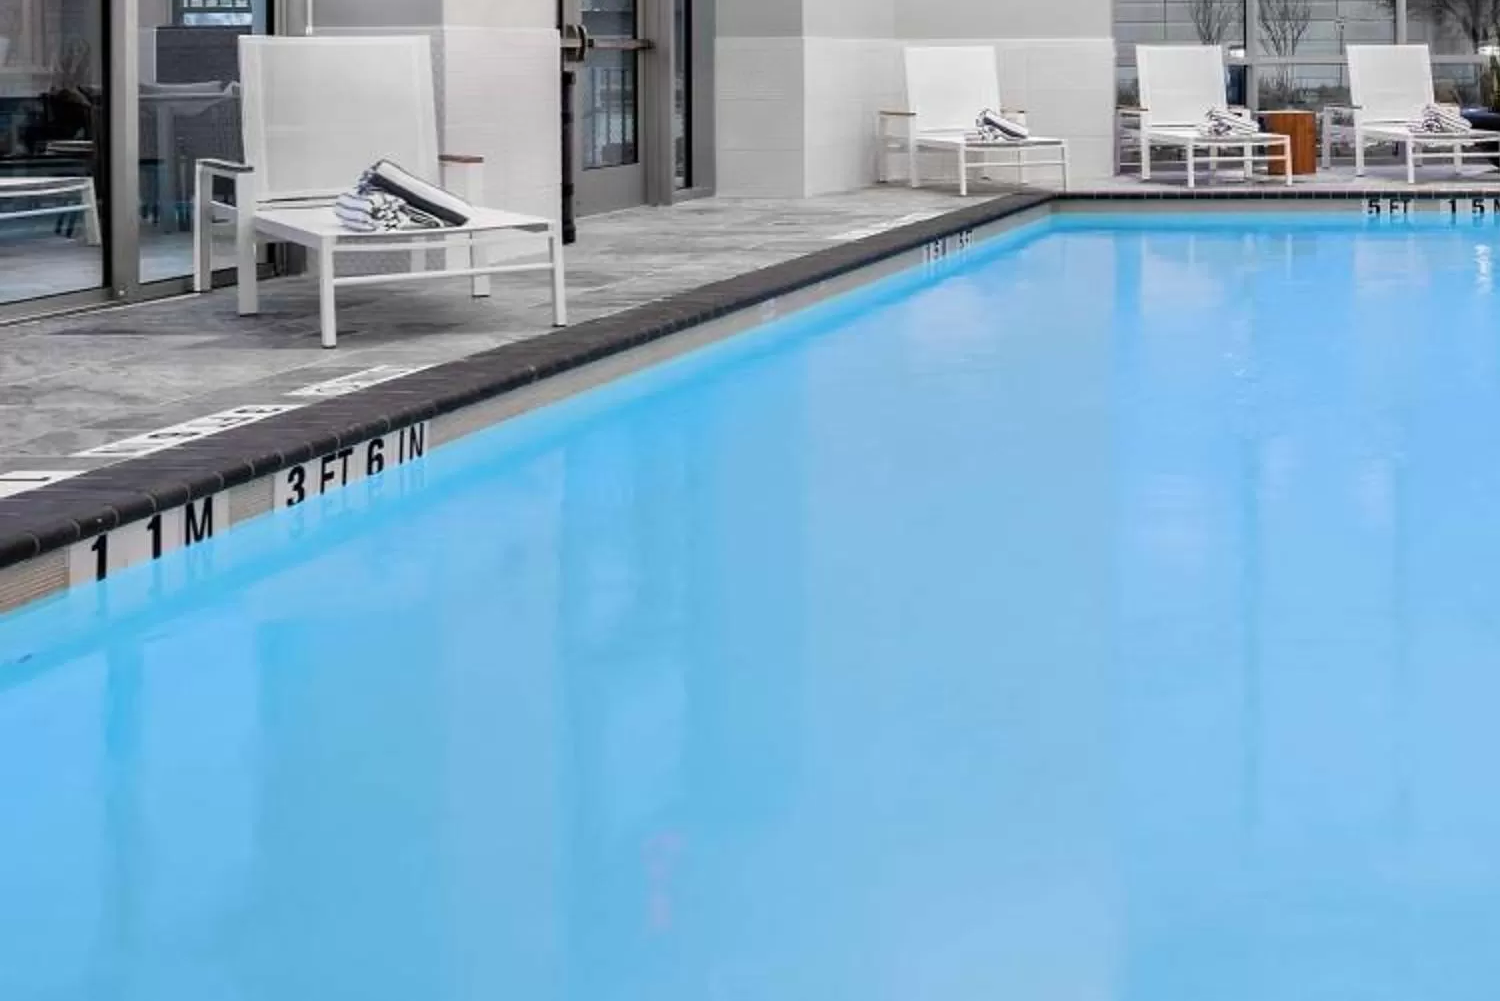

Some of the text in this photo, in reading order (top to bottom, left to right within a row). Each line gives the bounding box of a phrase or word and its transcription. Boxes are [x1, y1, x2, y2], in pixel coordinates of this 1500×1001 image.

[1368, 199, 1411, 214] 5 FT
[1448, 199, 1457, 214] 1
[1471, 199, 1485, 214] 5
[287, 422, 424, 506] 3 FT 6 IN
[92, 497, 213, 581] 1 1 M
